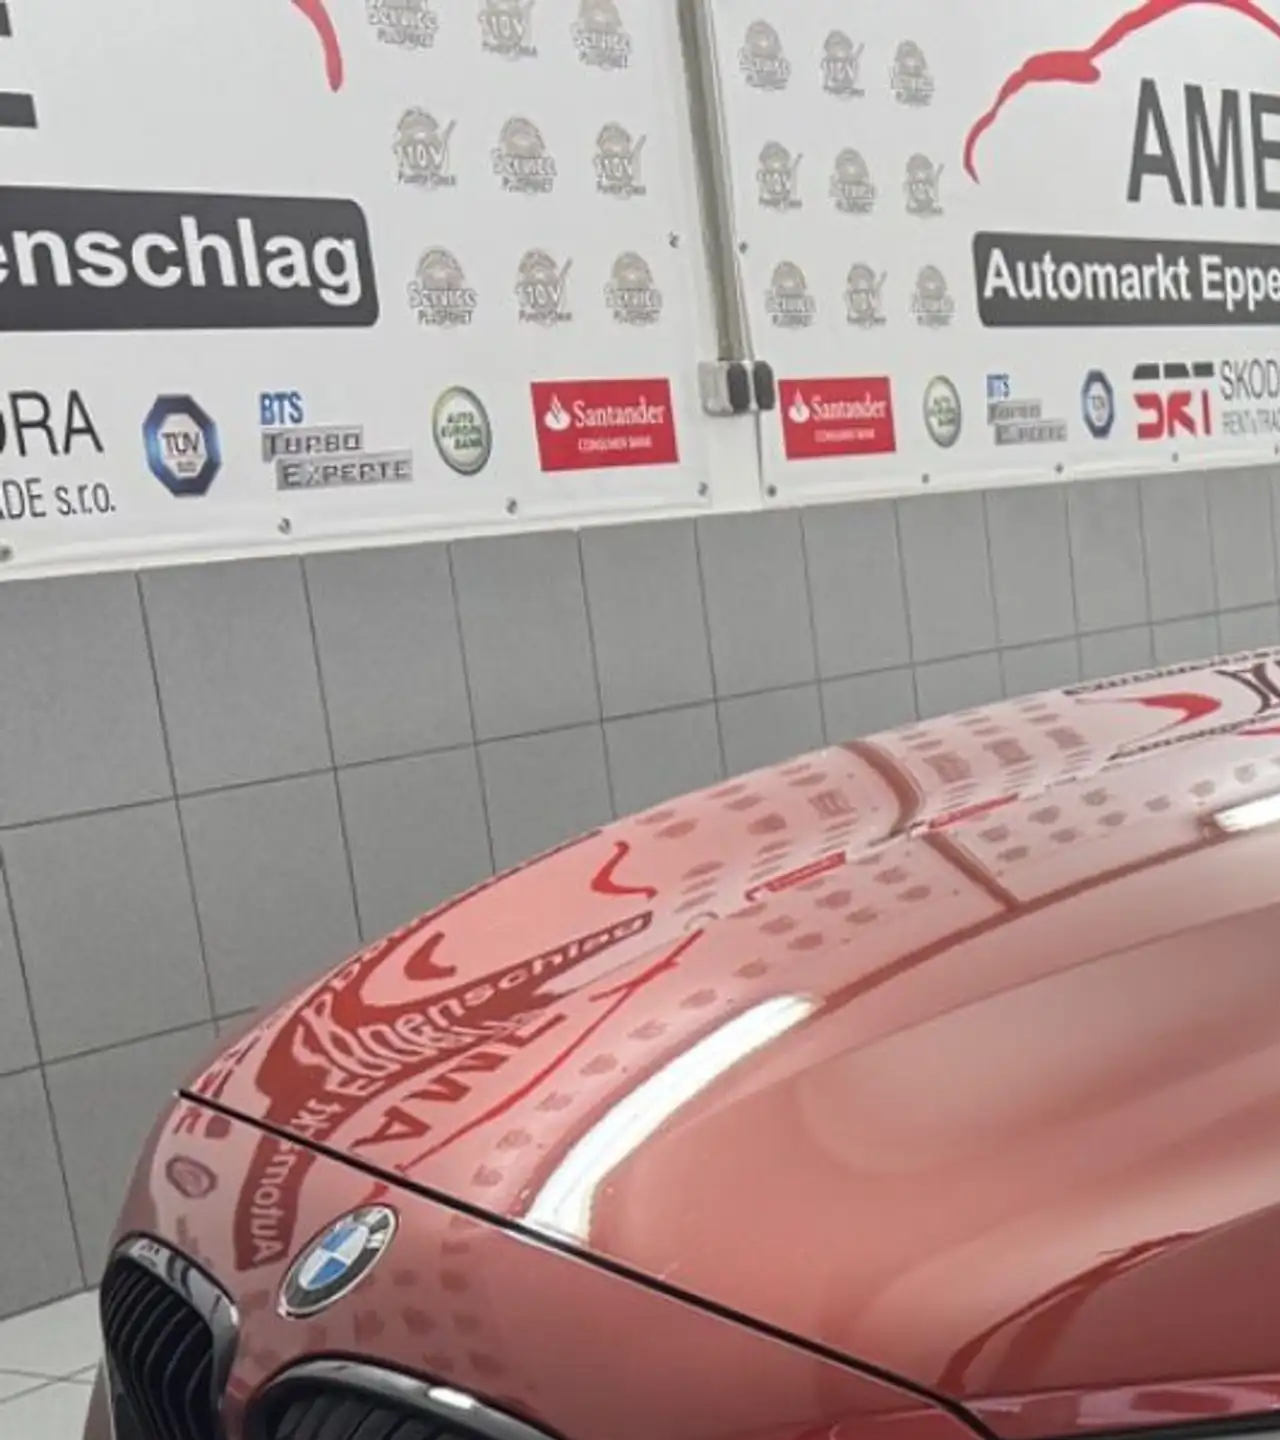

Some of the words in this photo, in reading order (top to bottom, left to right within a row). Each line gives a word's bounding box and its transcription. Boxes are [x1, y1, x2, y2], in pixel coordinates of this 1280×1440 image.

[983, 247, 1191, 301] Automarkt
[0, 389, 104, 458] RA
[259, 391, 304, 426] BTS
[572, 396, 665, 429] Santander
[811, 392, 887, 422] Santander
[0, 477, 47, 520] DE
[54, 482, 116, 516] s.r.o.
